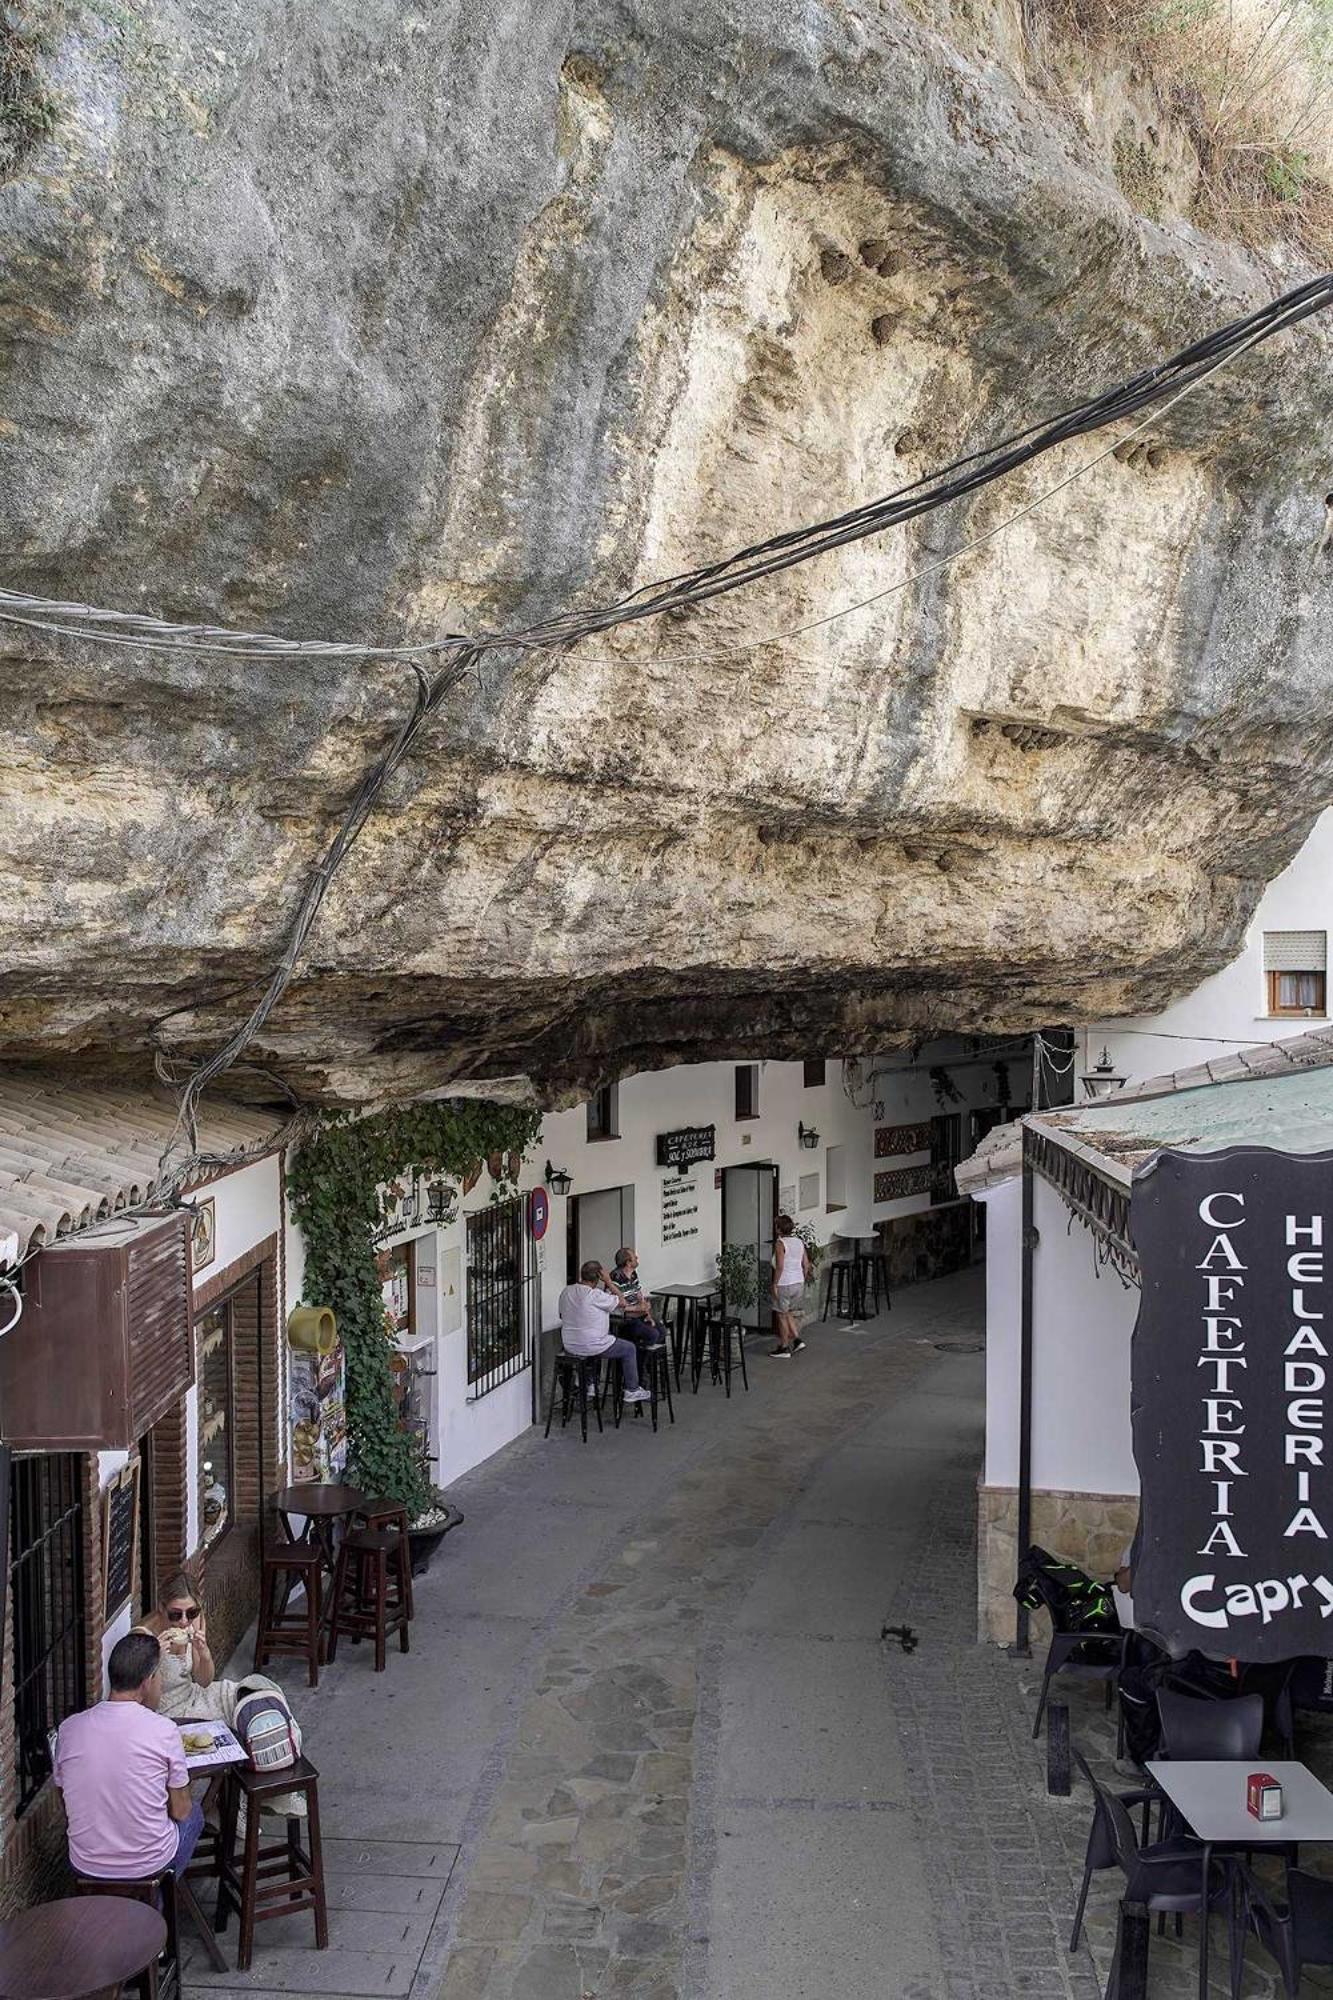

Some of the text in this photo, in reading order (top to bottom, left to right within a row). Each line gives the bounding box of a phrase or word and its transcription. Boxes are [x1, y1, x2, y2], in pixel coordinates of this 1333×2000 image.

[1195, 1192, 1248, 1557] CAFETERIA
[1283, 1215, 1329, 1539] HELADERIA
[1180, 1574, 1333, 1629] Capry
